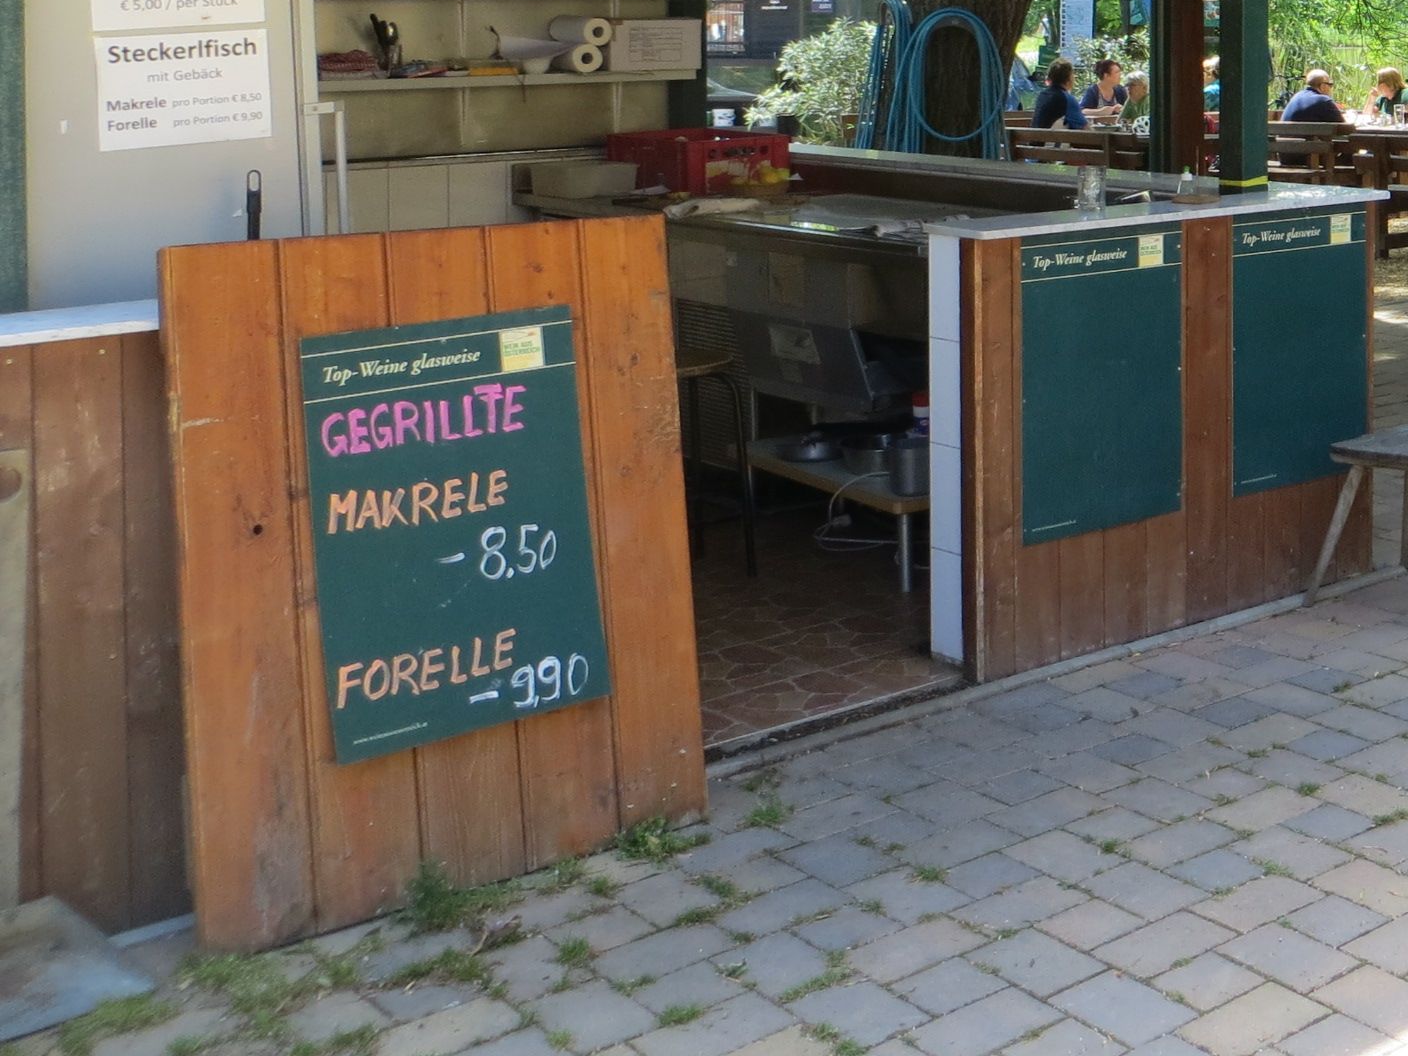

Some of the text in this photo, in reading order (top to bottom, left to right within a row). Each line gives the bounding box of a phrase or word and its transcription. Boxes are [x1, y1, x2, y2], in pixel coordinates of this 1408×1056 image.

[132, 0, 162, 11] 5,00
[107, 38, 257, 64] Steckerlfisch
[147, 68, 223, 82] mit Gebäck
[106, 97, 167, 112] Makrele
[107, 118, 158, 132] Forelle
[1242, 230, 1285, 247] Top-Weine
[1033, 253, 1084, 271] Top-Weine
[1085, 248, 1127, 266] glasweise
[322, 348, 480, 386] Top-Weine glasweise
[321, 383, 526, 457] GEGRILLTE
[327, 470, 508, 534] MAKRELE
[336, 628, 516, 709] FORELLE
